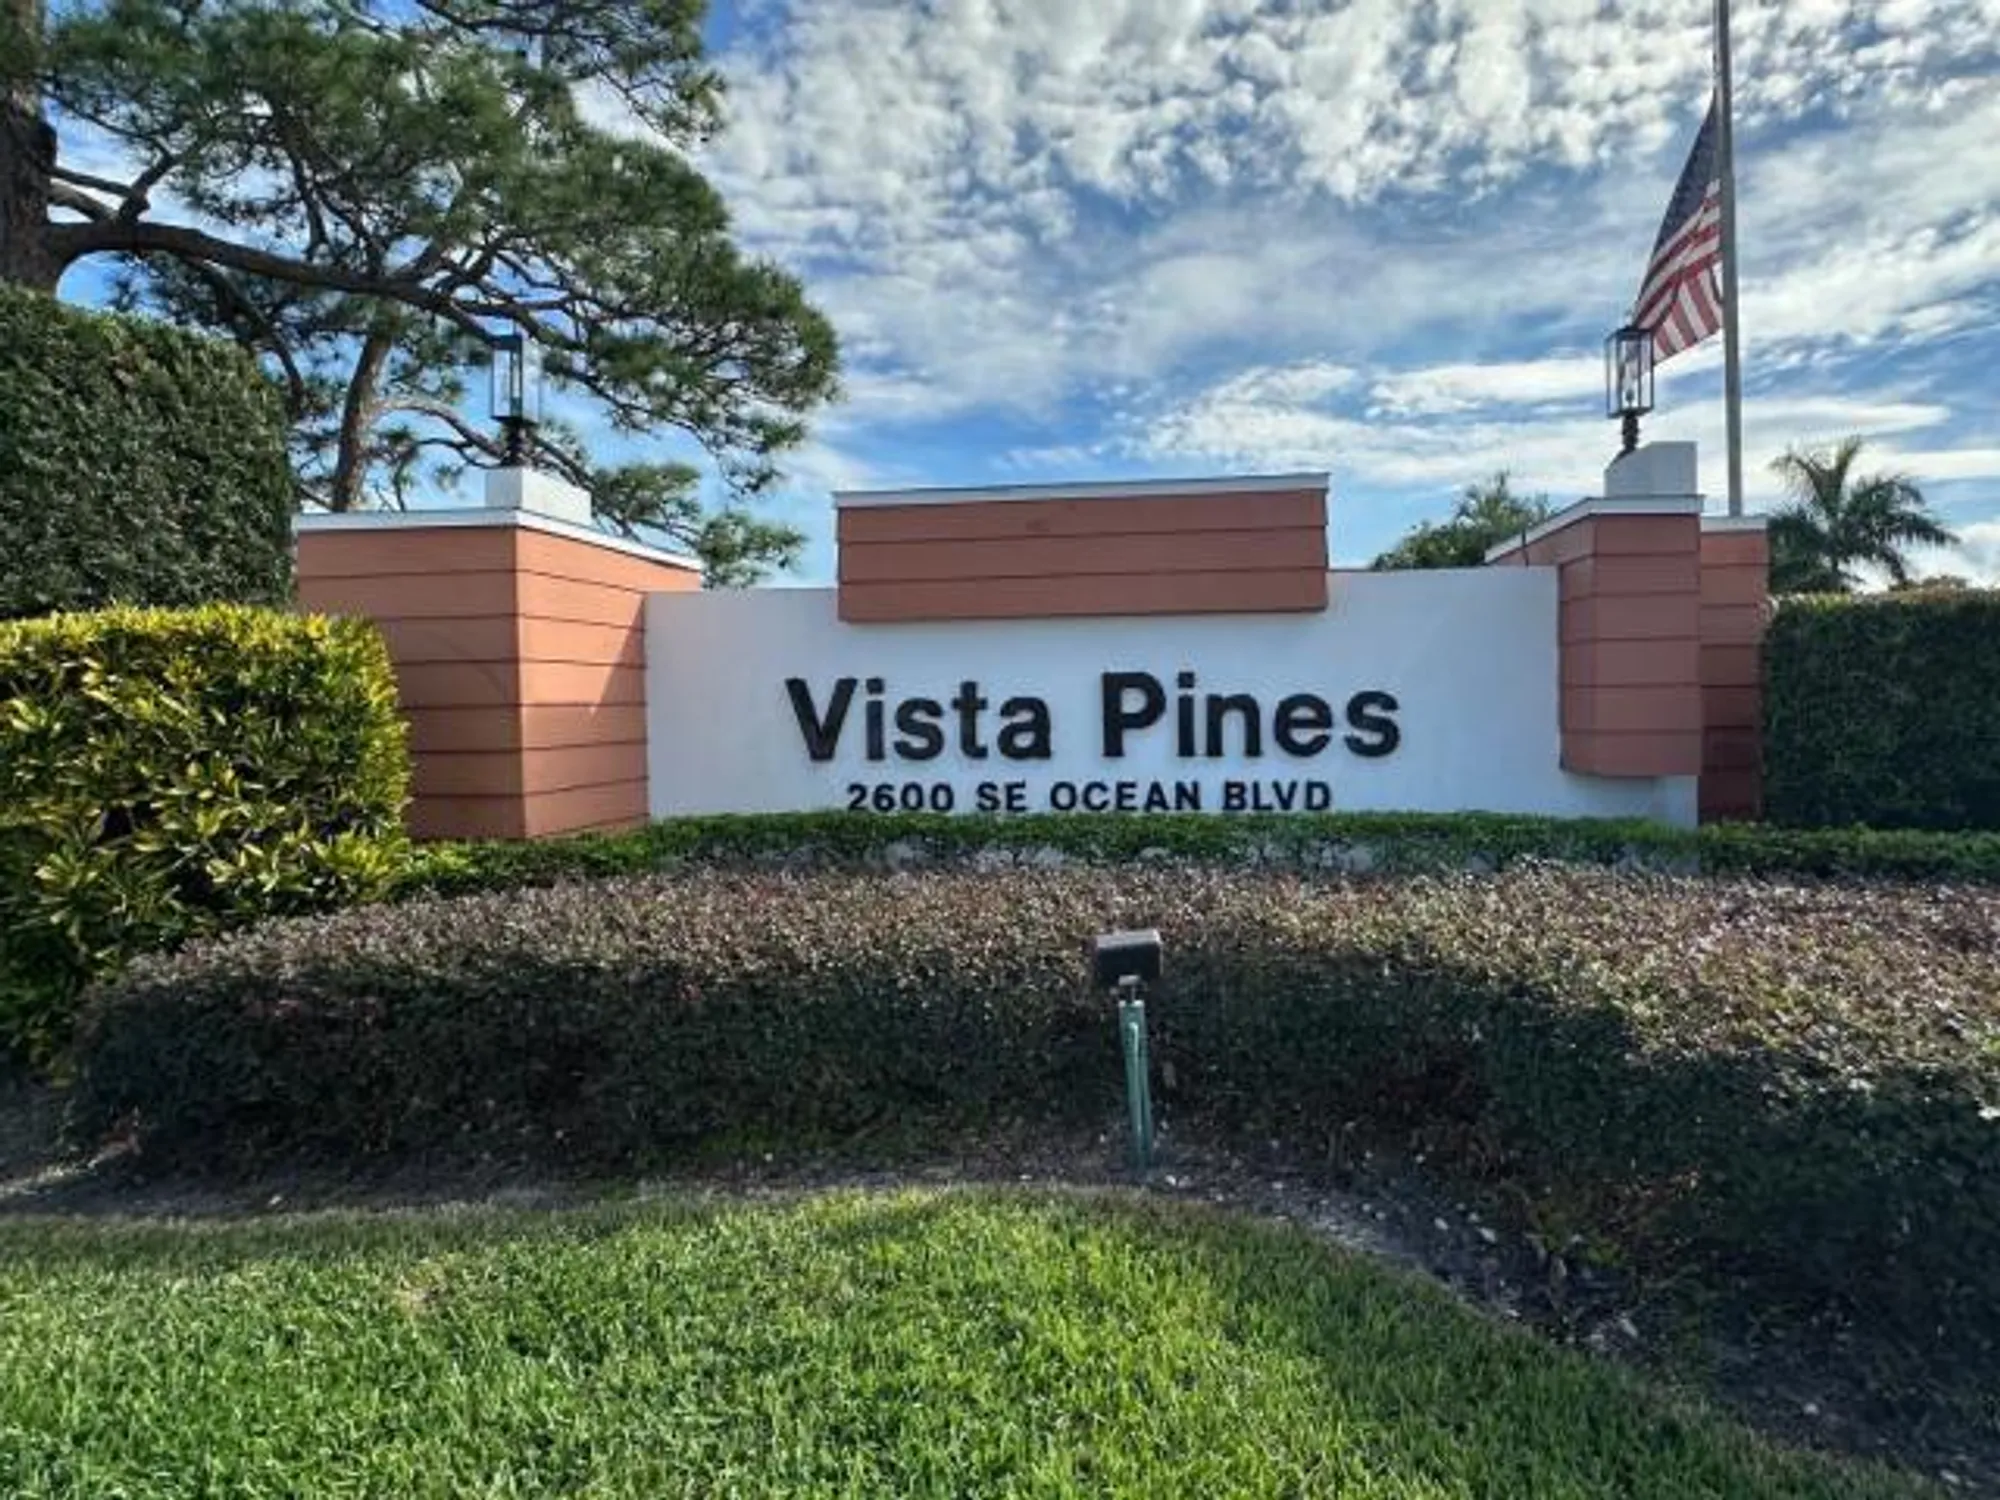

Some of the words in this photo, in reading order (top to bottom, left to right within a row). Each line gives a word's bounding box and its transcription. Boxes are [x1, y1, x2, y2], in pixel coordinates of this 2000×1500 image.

[785, 677, 1052, 762] Vista
[1101, 671, 1401, 759] Pines
[846, 782, 955, 813] 2600
[974, 781, 1028, 812] SE
[1049, 780, 1203, 812] OCEAN
[1221, 780, 1332, 812] BLVD
